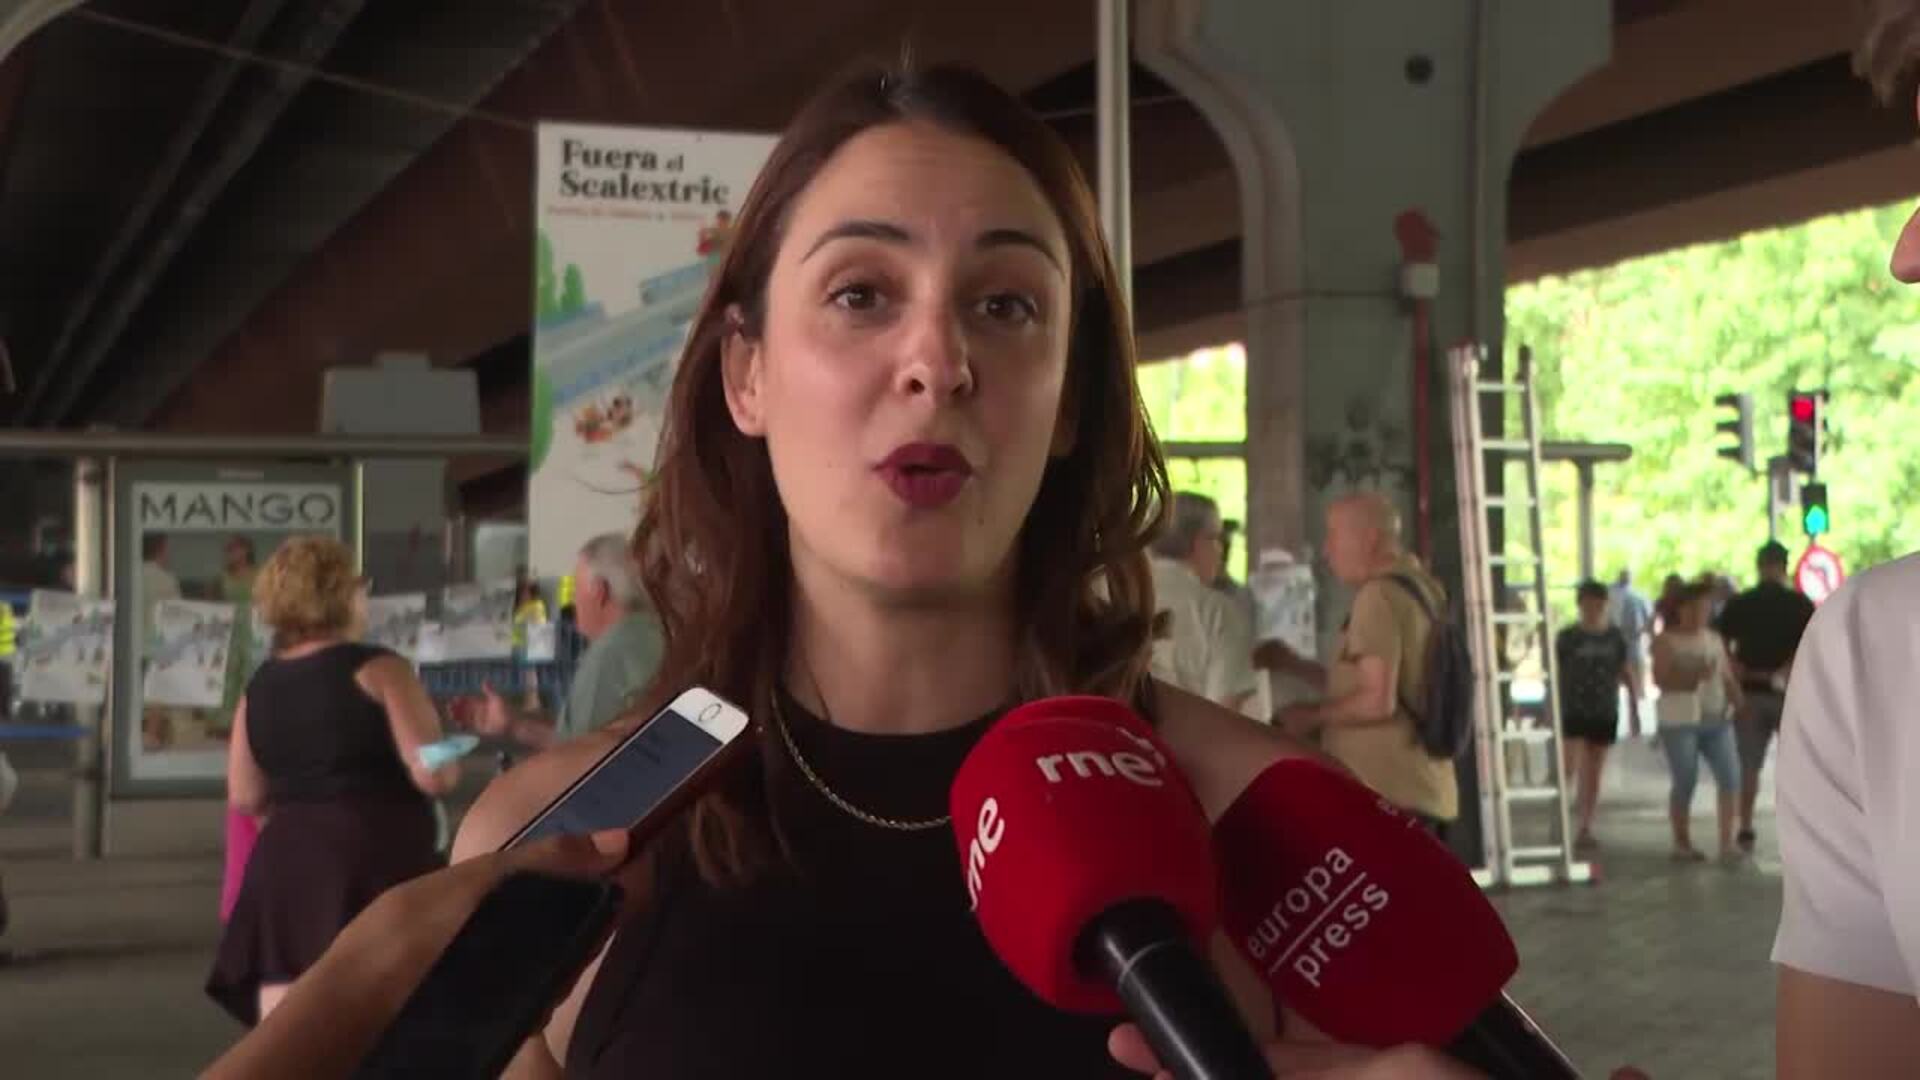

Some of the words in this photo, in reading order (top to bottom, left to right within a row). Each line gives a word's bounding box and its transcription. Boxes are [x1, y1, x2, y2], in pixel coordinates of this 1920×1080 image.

[561, 138, 658, 171] Fuera
[667, 155, 684, 172] el
[559, 169, 729, 205] Scalextric
[140, 491, 335, 525] MANGO
[1036, 751, 1164, 787] rne
[1248, 846, 1354, 958] europa
[1293, 883, 1390, 988] press
